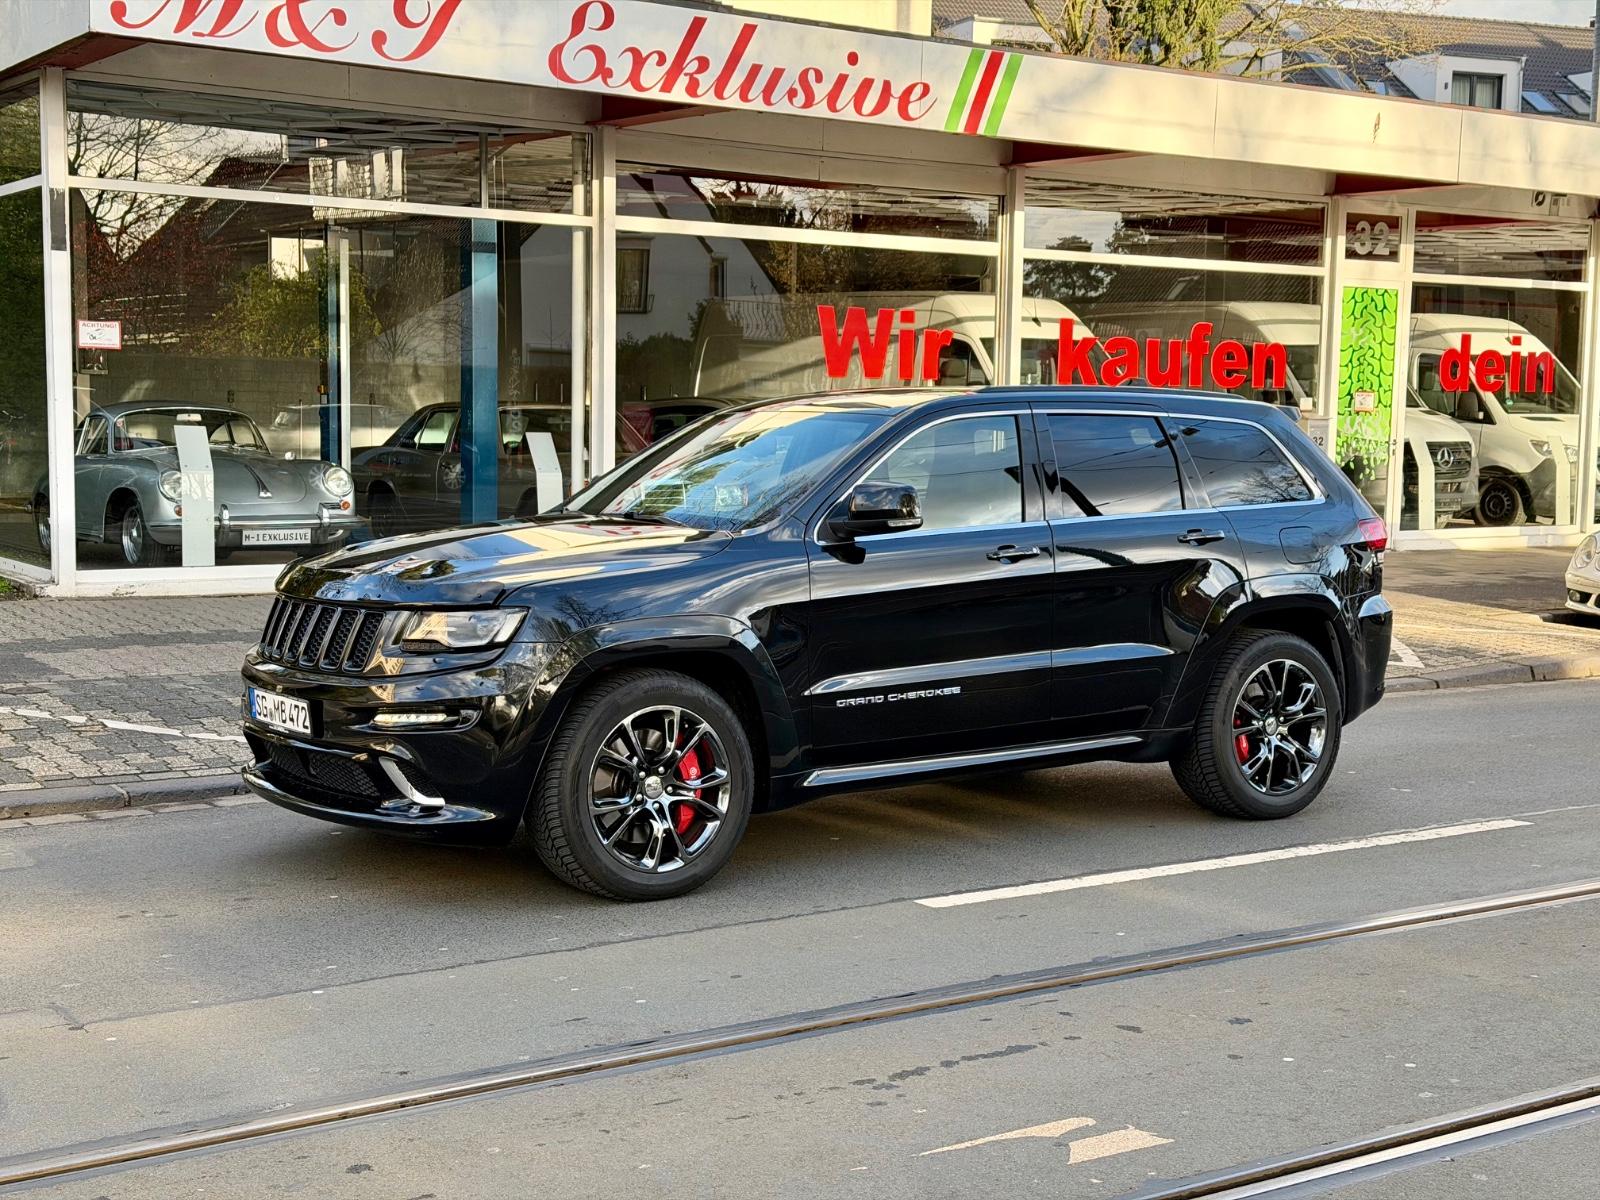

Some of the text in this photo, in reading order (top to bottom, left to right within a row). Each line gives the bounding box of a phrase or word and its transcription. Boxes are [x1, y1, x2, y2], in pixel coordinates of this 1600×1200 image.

[548, 0, 938, 121] Exklusive
[1354, 220, 1390, 256] 32
[817, 304, 1555, 393] Wir kaufen dein
[1312, 436, 1323, 446] 32
[262, 532, 309, 542] EXKLUSIVE
[256, 694, 309, 729] SG MB 472
[836, 686, 962, 707] GRAND CHEROKEE
